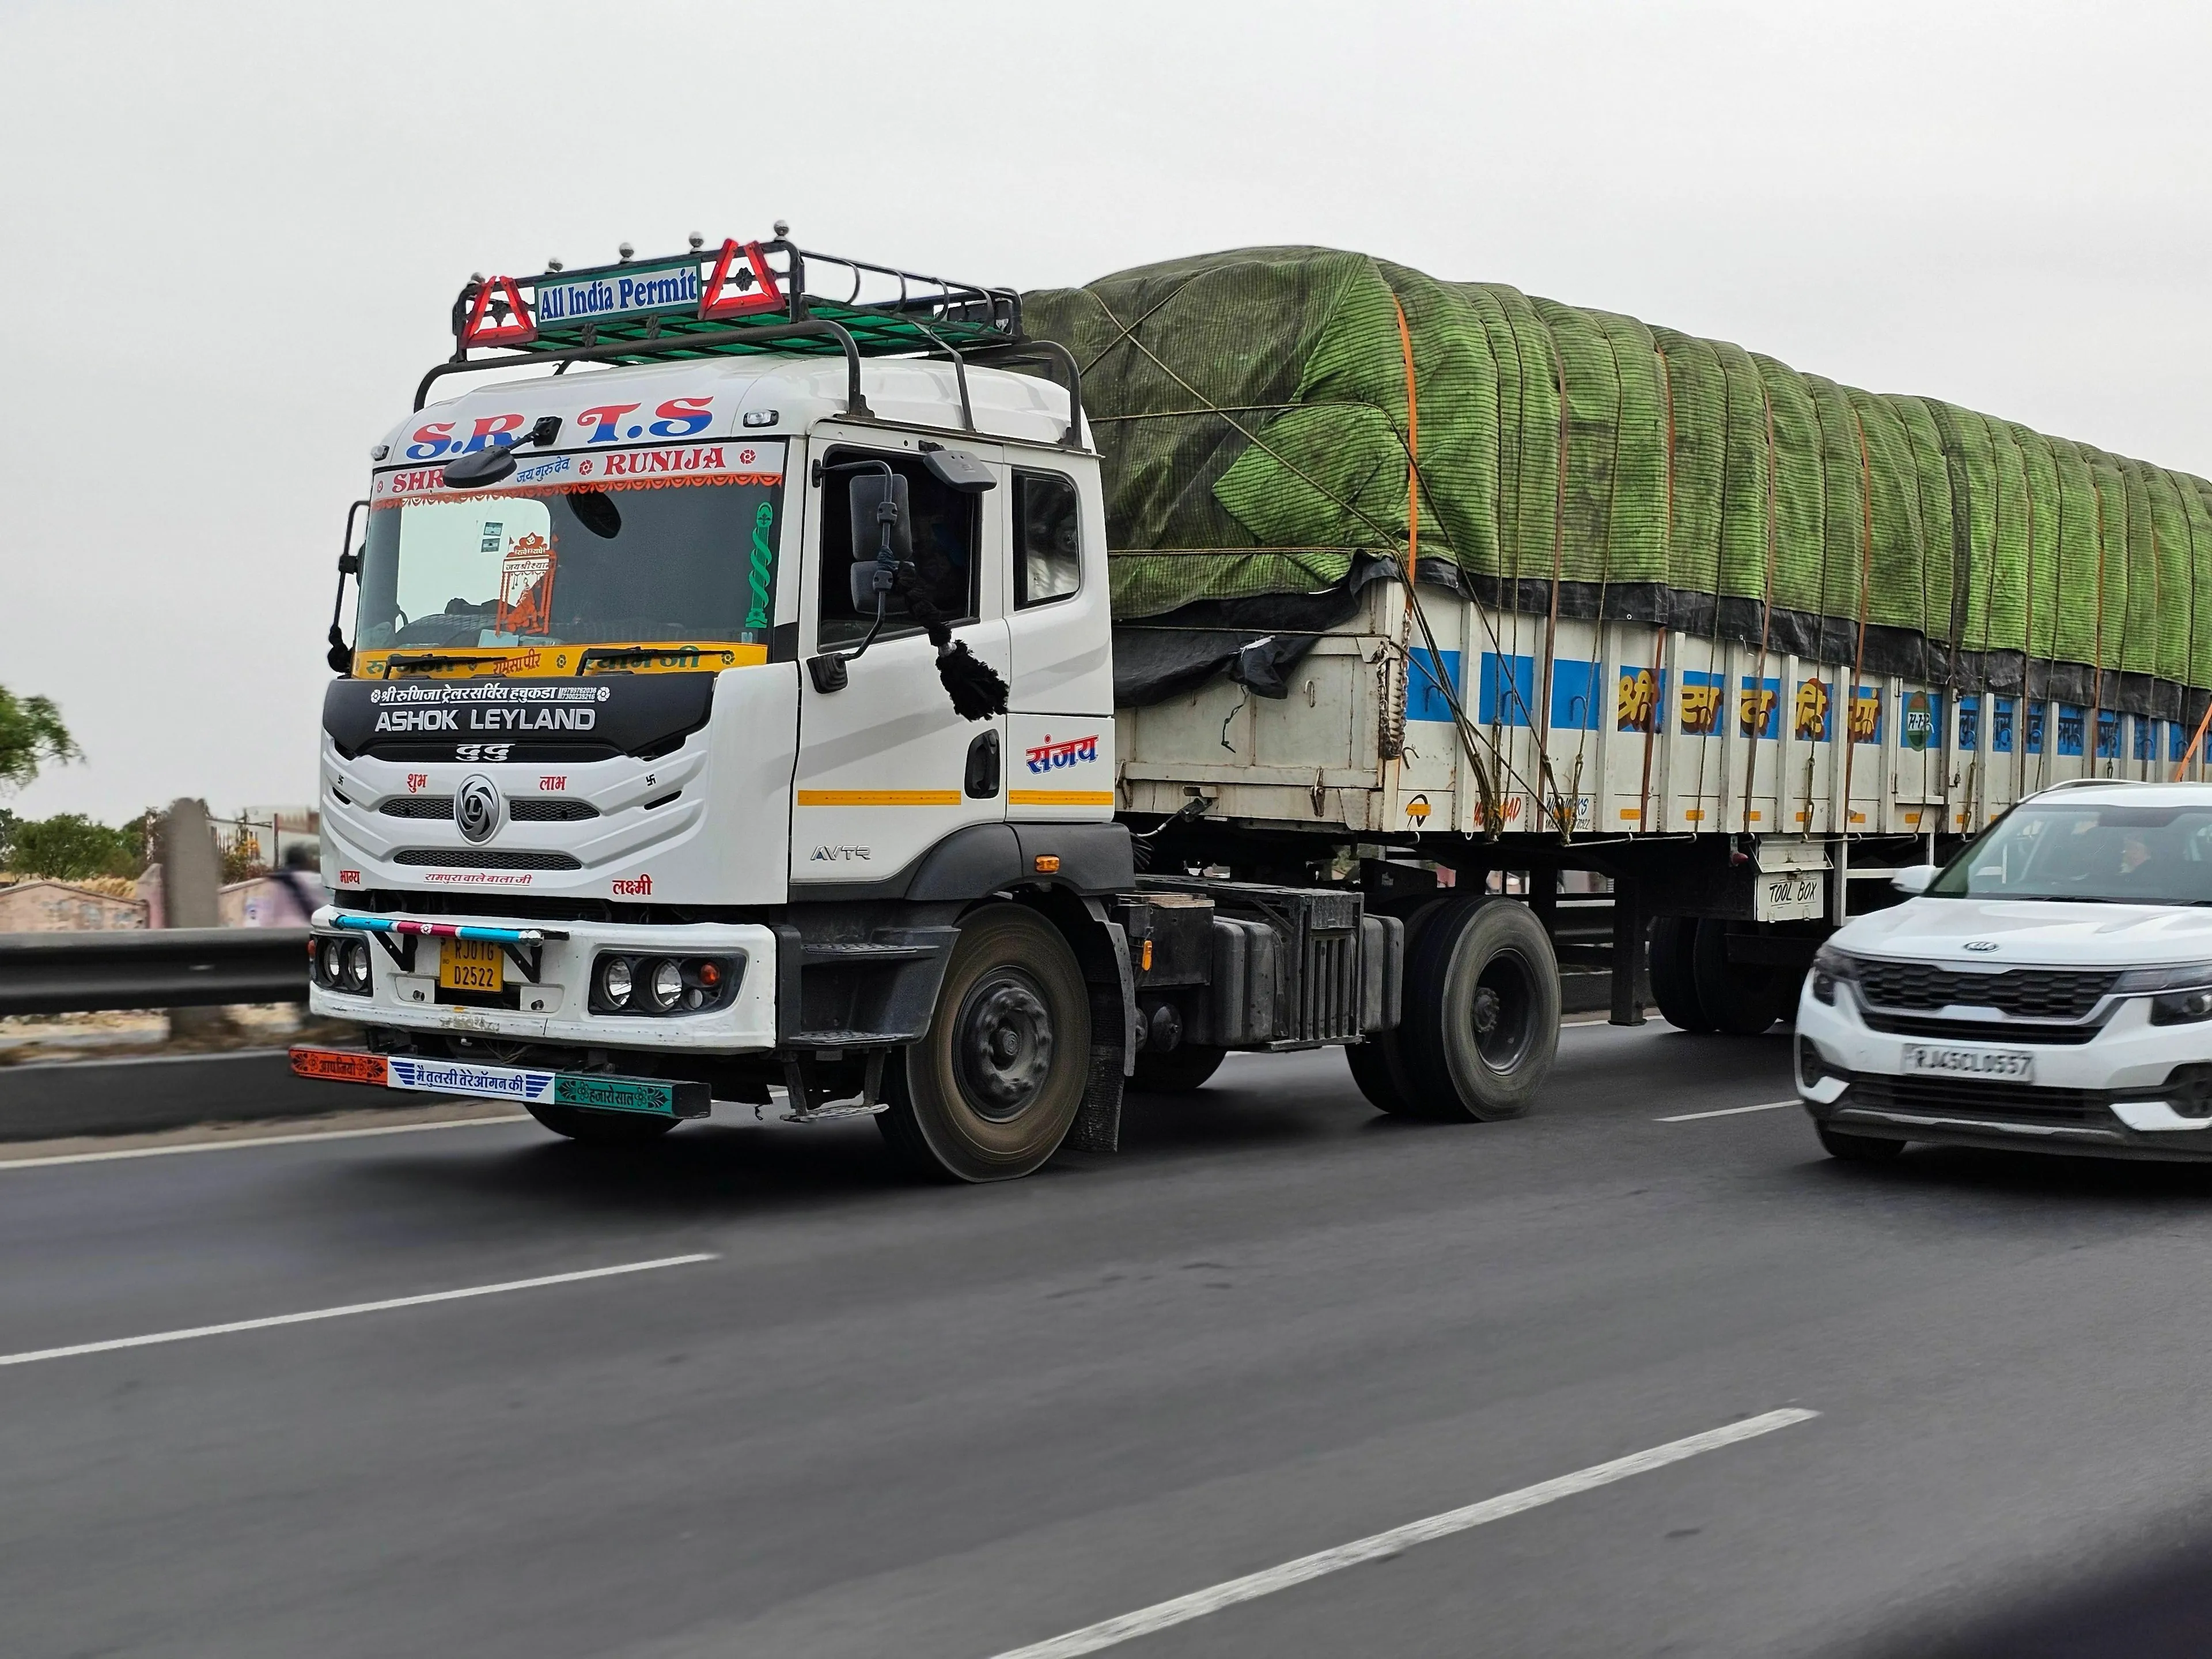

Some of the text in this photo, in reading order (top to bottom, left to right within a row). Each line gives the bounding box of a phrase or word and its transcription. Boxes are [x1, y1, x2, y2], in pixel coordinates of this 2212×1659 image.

[540, 267, 698, 320] All India Permit
[577, 395, 714, 444] T.S
[516, 456, 571, 484] जय गुरु देव
[603, 446, 726, 476] RUNIJA
[392, 468, 445, 493] SHR
[381, 685, 396, 702] श्री
[375, 707, 596, 732] ASHOK LEYLAND
[1025, 734, 1099, 775] संजय
[407, 773, 428, 794] शुभ
[539, 775, 567, 791] लाभ
[810, 845, 871, 861] AVTR
[340, 870, 361, 885] भाग्य
[612, 874, 653, 895] लक्ष्मी
[1769, 881, 1817, 903] TOOL BOX
[454, 939, 494, 961] RJ01G
[454, 966, 494, 987] D2522
[425, 1069, 459, 1088] तुलसी
[507, 1074, 524, 1092] की
